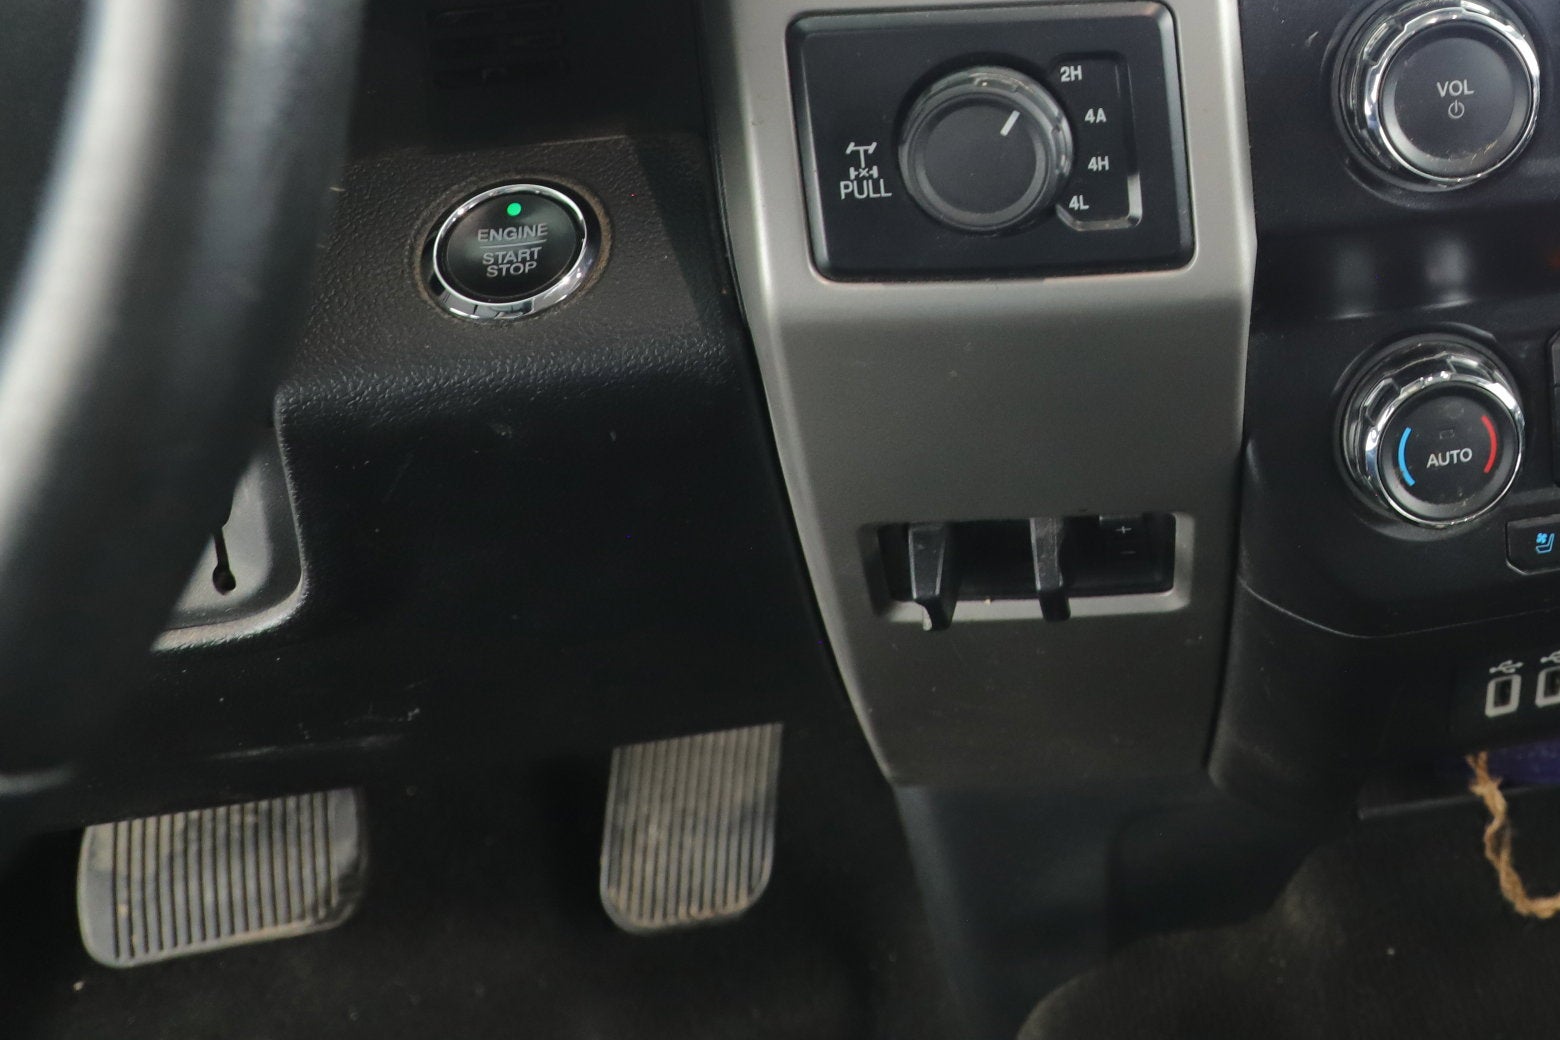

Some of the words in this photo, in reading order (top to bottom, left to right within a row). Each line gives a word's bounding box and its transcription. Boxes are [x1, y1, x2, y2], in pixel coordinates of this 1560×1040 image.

[1061, 65, 1082, 82] 2H
[1437, 79, 1475, 99] VOL
[1085, 108, 1106, 123] 4A
[1088, 156, 1109, 171] 4H
[839, 180, 893, 200] PULL
[1068, 196, 1089, 210] 4L
[478, 223, 548, 242] ENGINE
[482, 246, 542, 265] START
[486, 261, 537, 278] STOP
[1427, 448, 1472, 468] AUTO
